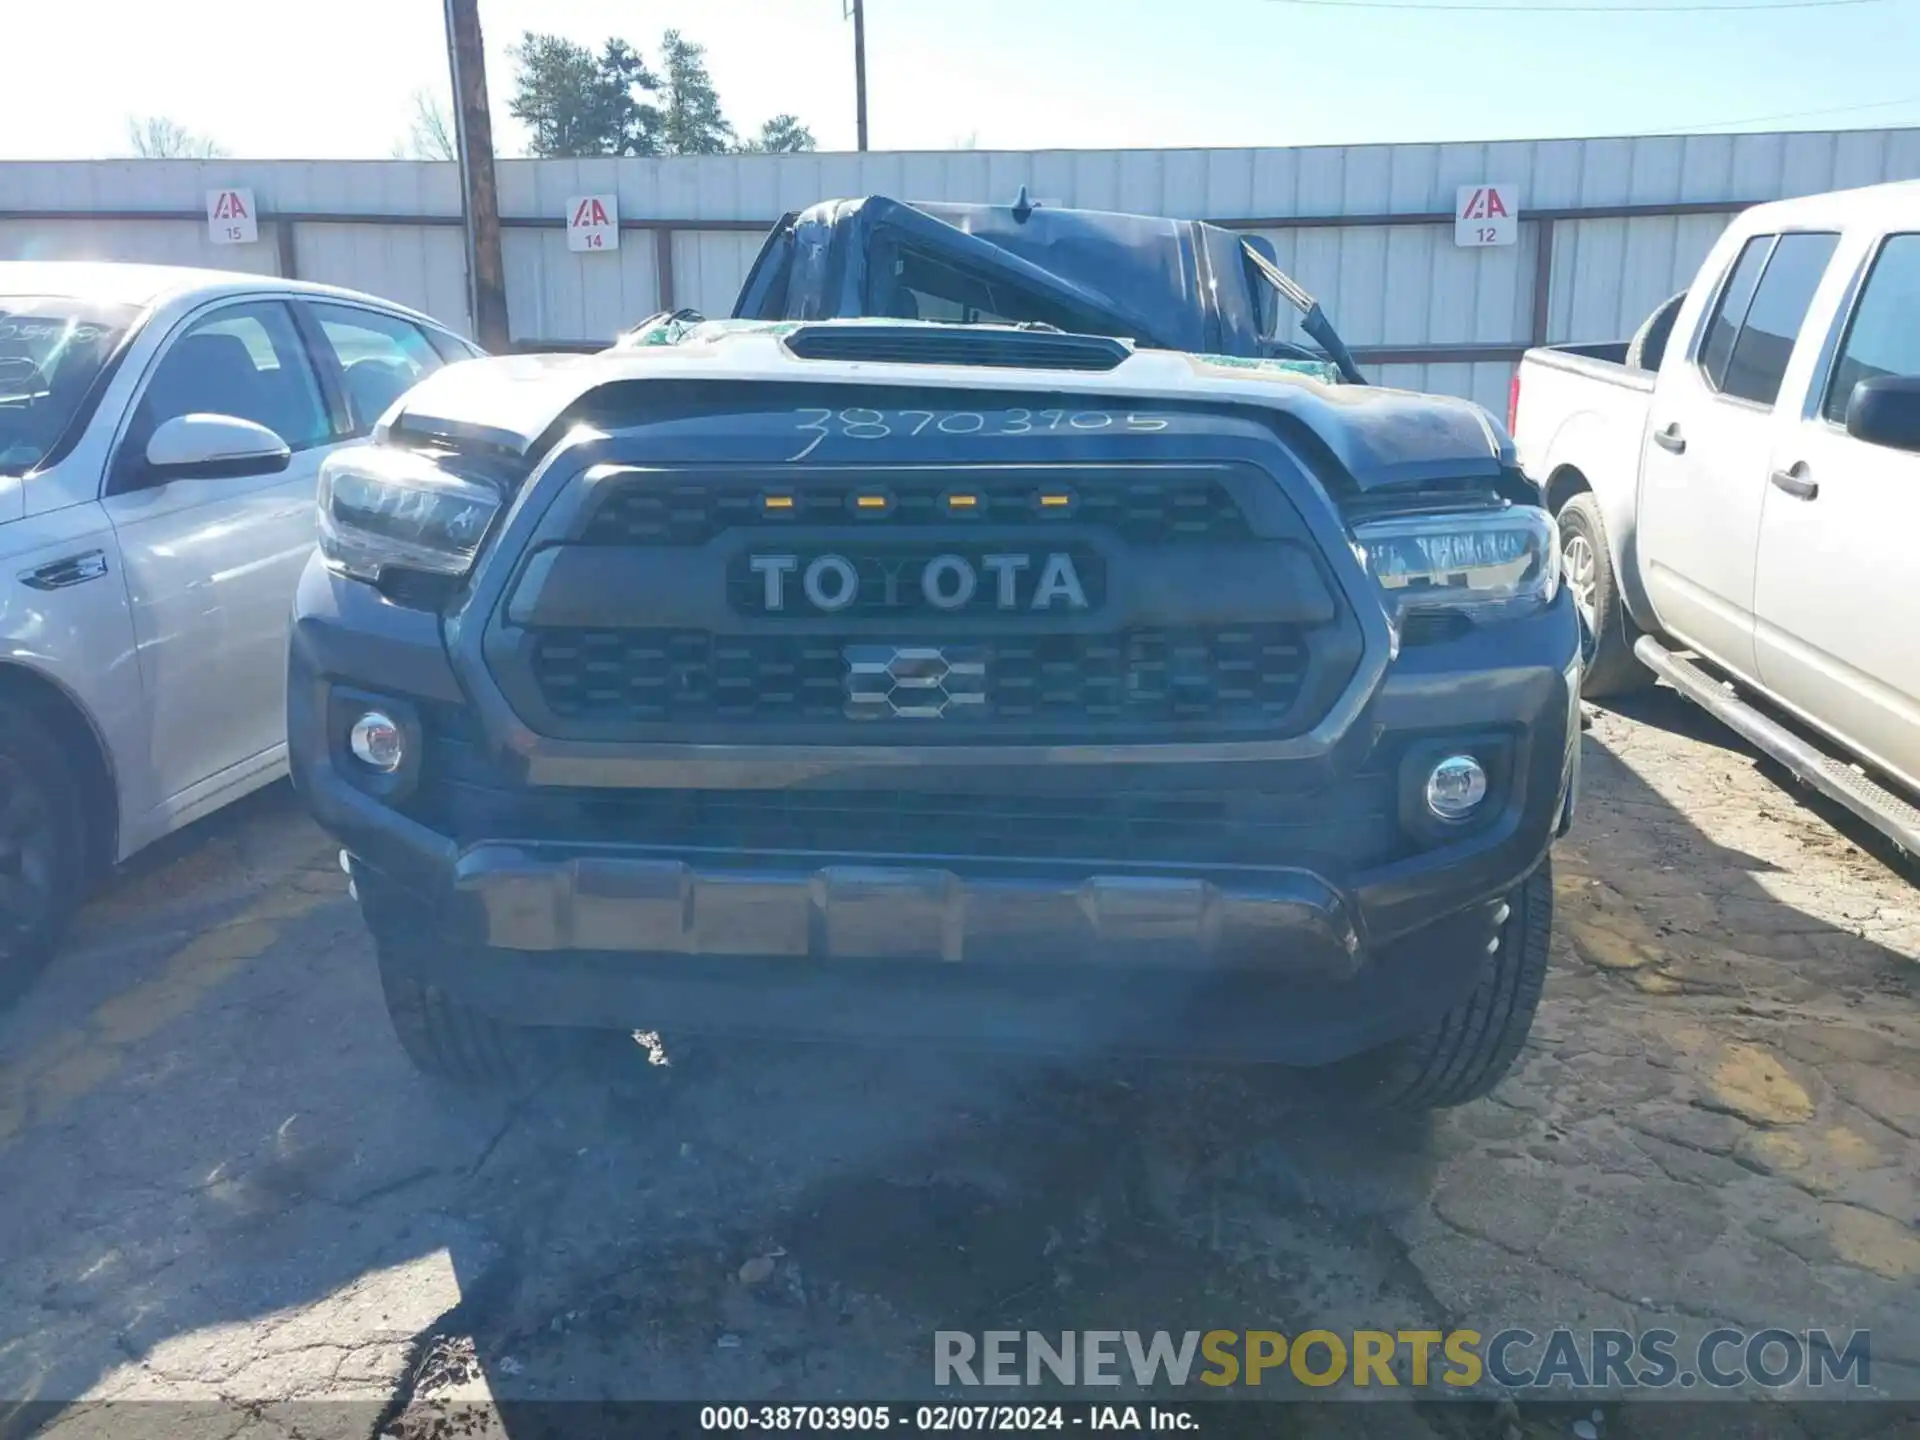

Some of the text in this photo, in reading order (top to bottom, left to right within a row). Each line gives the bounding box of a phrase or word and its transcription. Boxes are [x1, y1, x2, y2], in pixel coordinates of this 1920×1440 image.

[224, 227, 242, 240] 15
[1476, 227, 1496, 242] 12
[584, 234, 602, 248] 14
[749, 552, 1088, 612] TOYOTA
